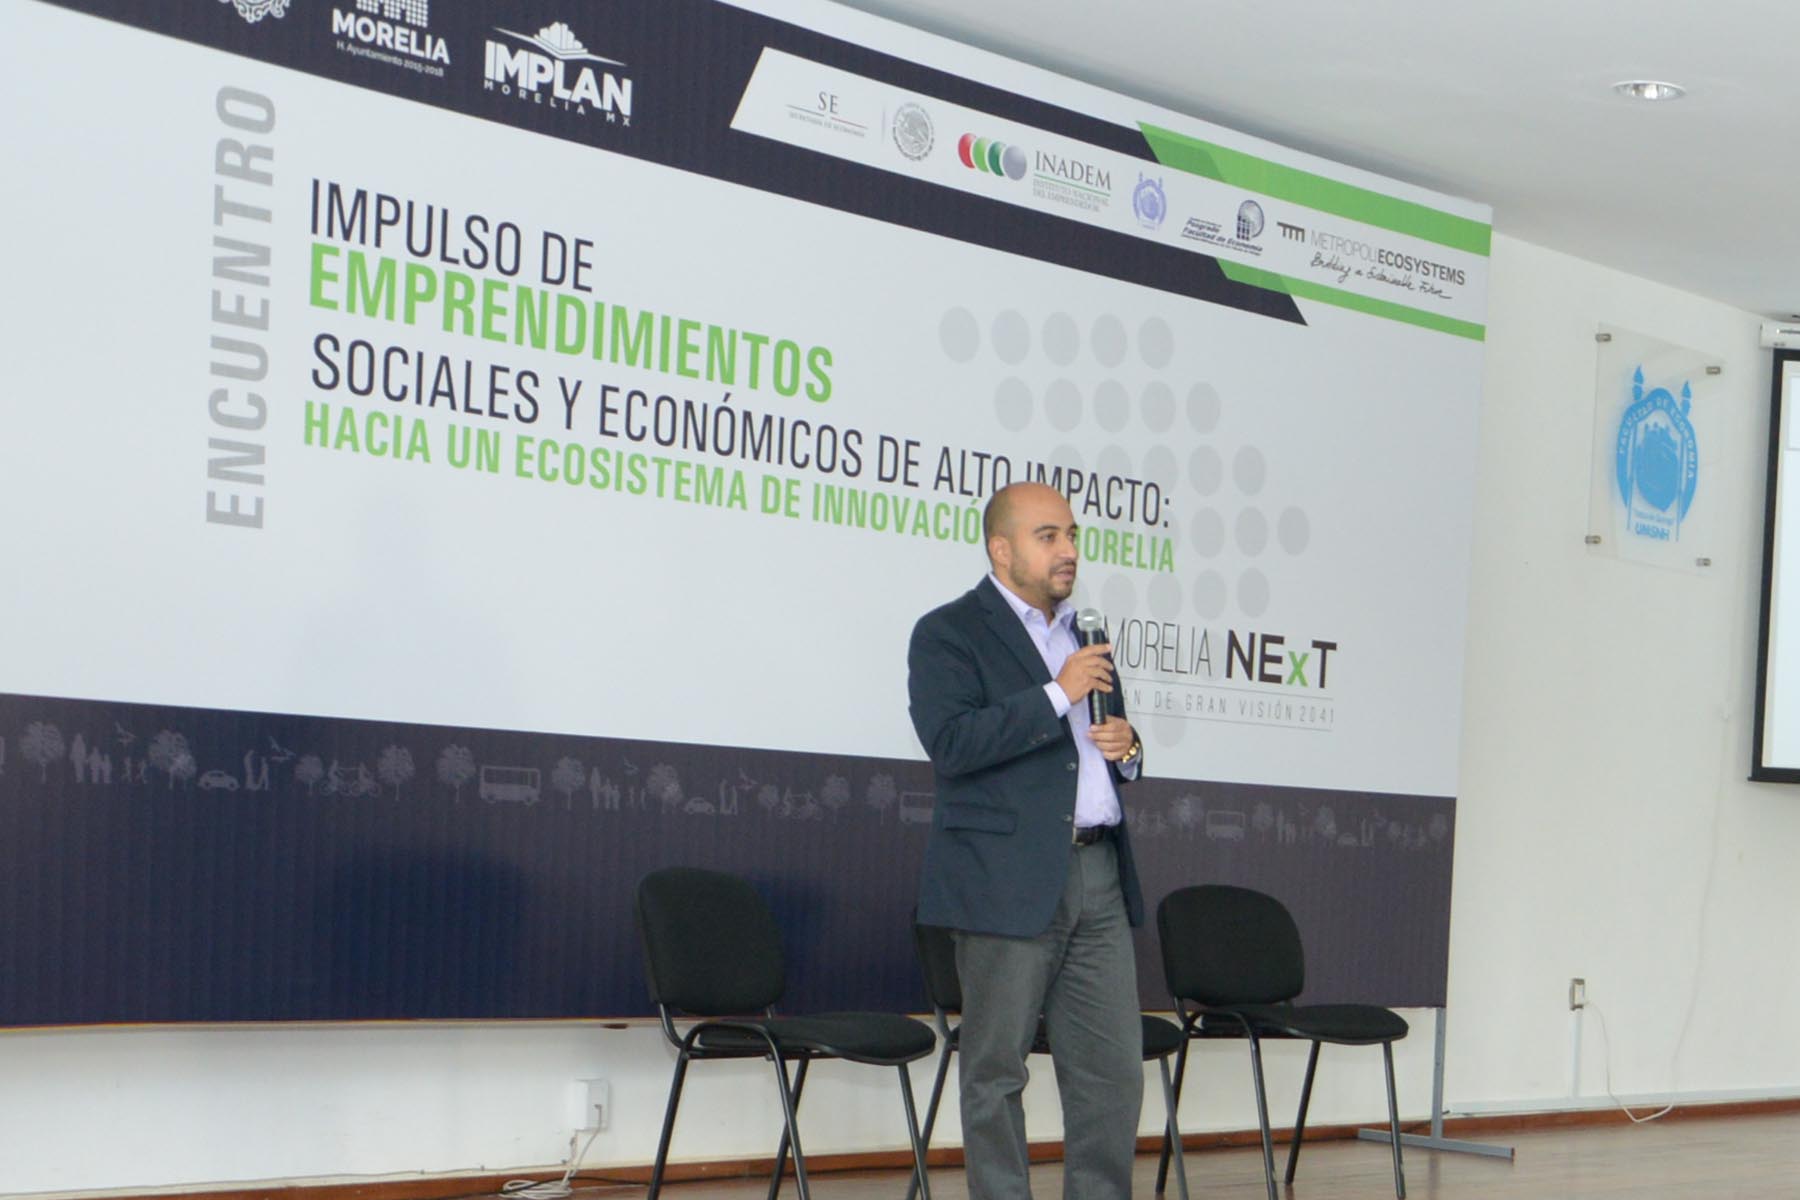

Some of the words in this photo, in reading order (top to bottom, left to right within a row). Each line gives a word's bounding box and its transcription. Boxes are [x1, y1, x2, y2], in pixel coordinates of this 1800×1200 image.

[332, 8, 450, 65] MORELIA
[484, 40, 632, 116] IMPLAN
[484, 79, 586, 116] MORELIA
[818, 91, 839, 114] SE
[1034, 150, 1112, 191] INADEM
[311, 178, 522, 278] IMPULSO
[541, 230, 595, 293] DE
[205, 84, 277, 529] ENCUENTRO
[308, 241, 834, 403] EMPRENDIMIENTOS
[312, 333, 540, 424] SOCIALES
[558, 375, 583, 431] Y
[600, 384, 864, 478] ECONÓMICOS
[877, 433, 921, 488] DE
[934, 446, 1012, 499] ALTO
[303, 400, 432, 465] HACIA
[447, 423, 500, 474] UN
[515, 434, 748, 512] ECOSISTEMA
[761, 474, 801, 519] DE
[812, 483, 981, 546] INNOVACIÓ
[1076, 525, 1174, 573] ORELIA
[1154, 690, 1173, 711] DE
[1186, 694, 1227, 714] GRAN
[1239, 699, 1293, 721] VISIÓN
[1299, 705, 1335, 724] 2041
